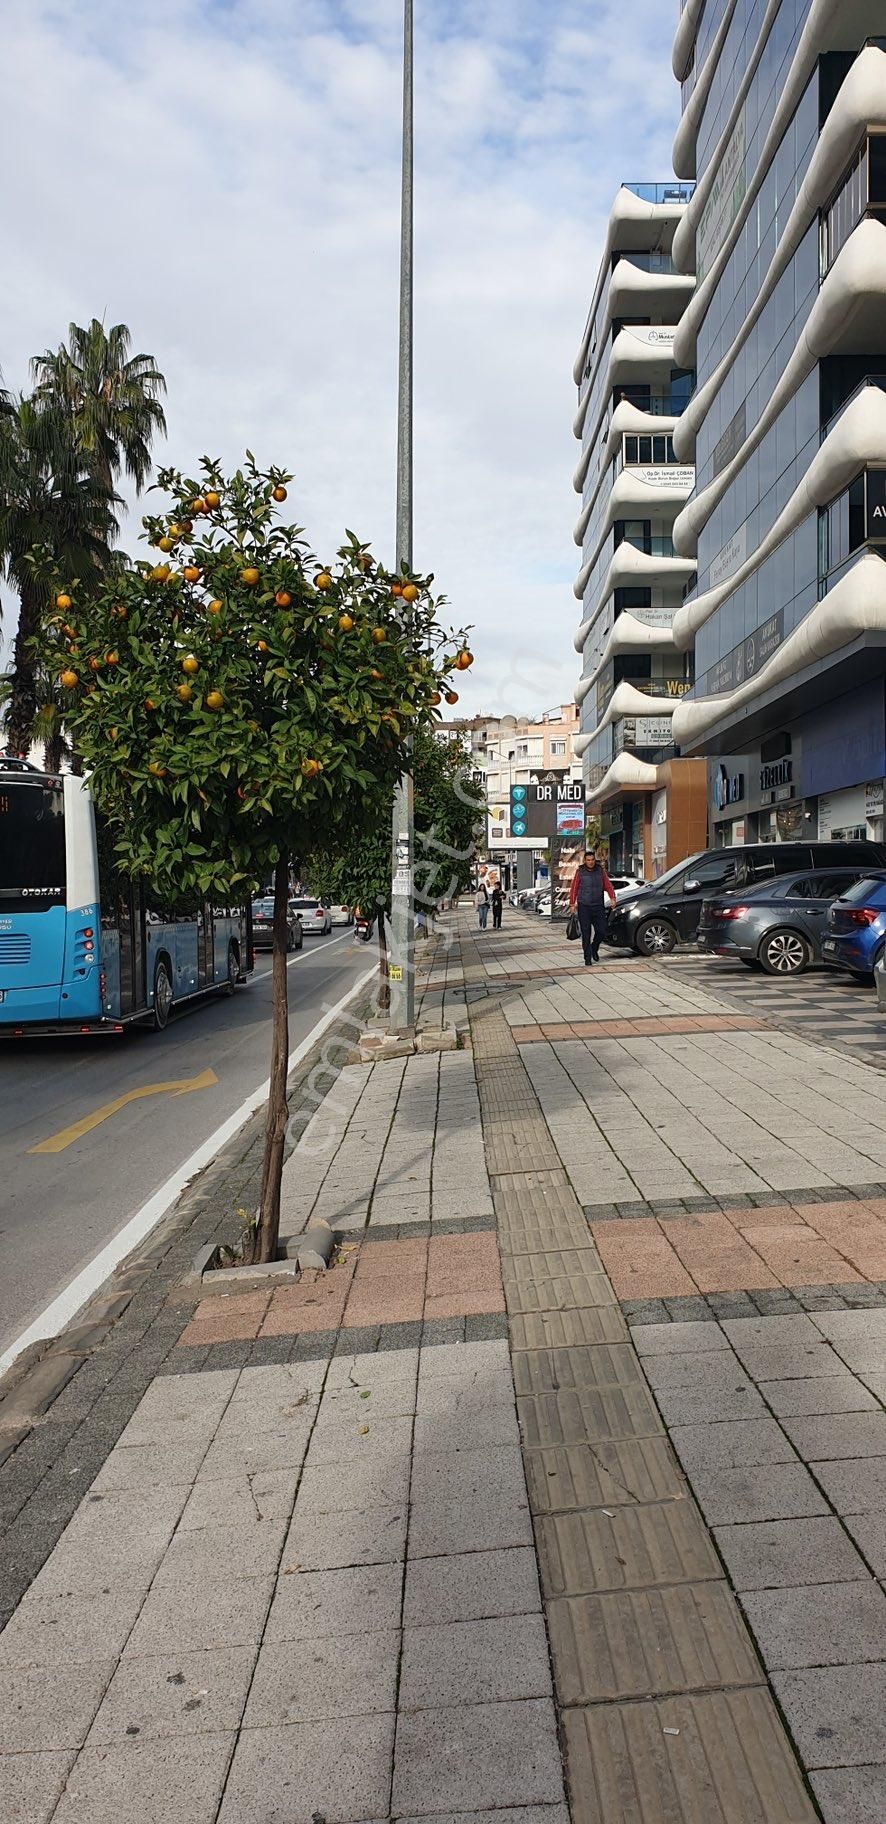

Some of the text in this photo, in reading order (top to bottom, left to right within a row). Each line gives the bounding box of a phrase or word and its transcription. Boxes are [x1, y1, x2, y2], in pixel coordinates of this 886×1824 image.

[536, 785, 582, 800] DR MED
[22, 888, 61, 896] OTOKAR
